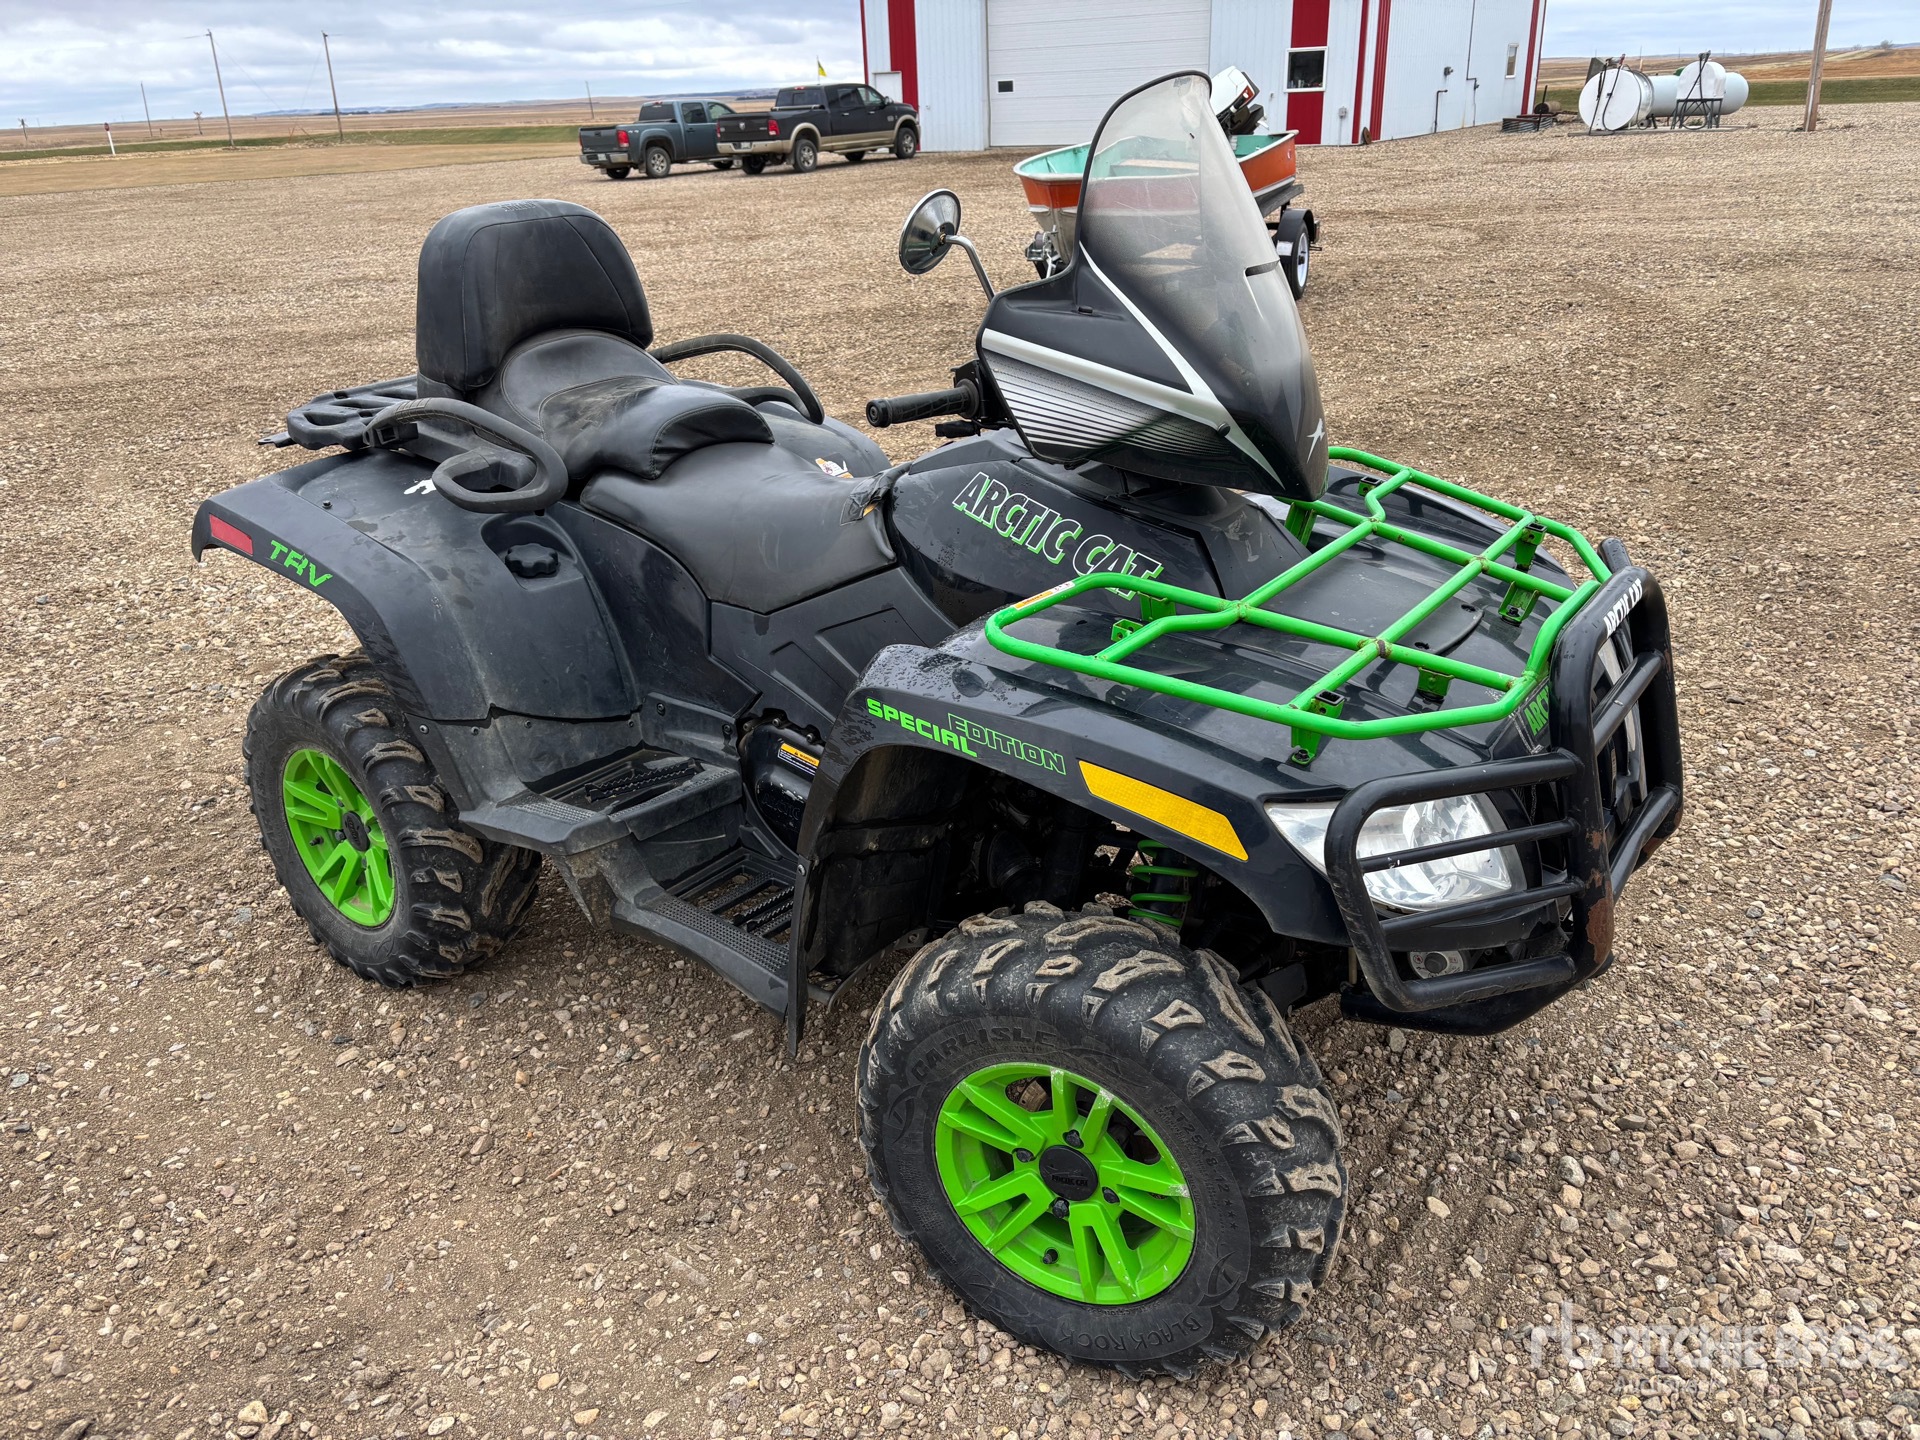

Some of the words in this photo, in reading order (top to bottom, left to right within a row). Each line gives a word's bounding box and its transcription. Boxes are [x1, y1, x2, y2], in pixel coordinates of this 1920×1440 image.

[270, 540, 333, 587] TRV
[952, 471, 1084, 564] ARCTIC
[1073, 534, 1164, 601] CAT
[1603, 593, 1630, 639] ARCTIC
[1629, 577, 1643, 609] CAT
[866, 697, 978, 758] SPECIAL
[947, 712, 1067, 776] EDITION
[910, 1026, 1057, 1082] CARLISLE
[1058, 1321, 1126, 1351] ROCK
[1128, 1311, 1203, 1349] BLACK
